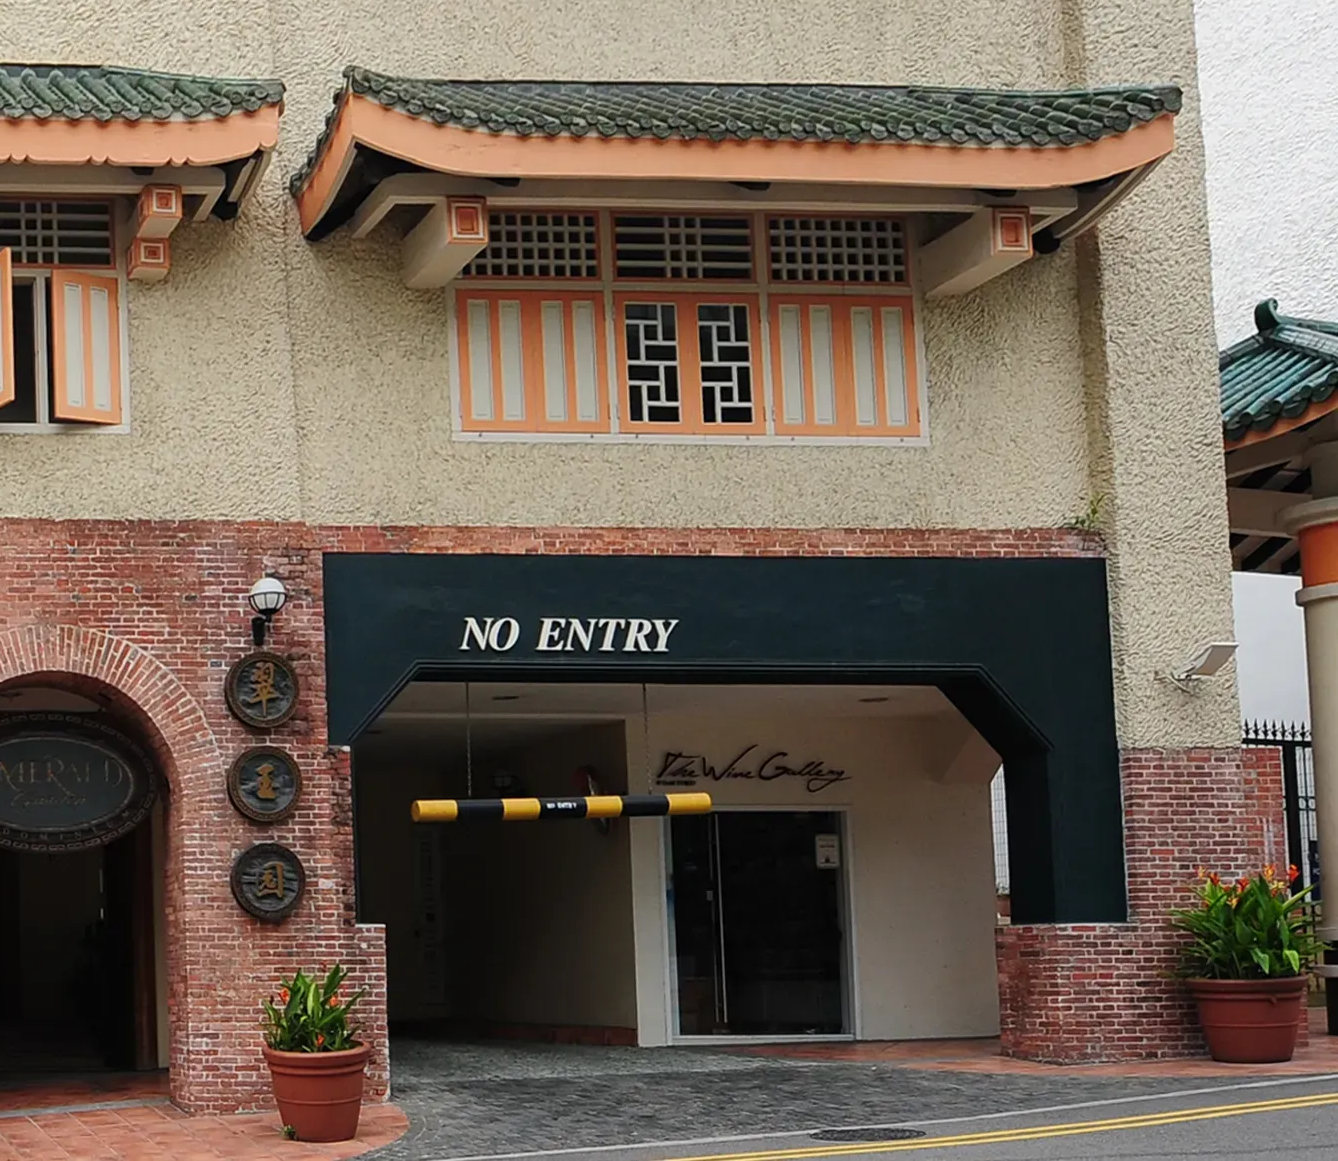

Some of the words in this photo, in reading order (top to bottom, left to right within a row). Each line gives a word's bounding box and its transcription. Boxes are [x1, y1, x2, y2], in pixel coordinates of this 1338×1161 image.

[459, 616, 521, 653] NO
[535, 618, 679, 654] ENTRY
[657, 752, 700, 778] The
[702, 744, 758, 781] Wine
[759, 751, 853, 792] Gallery
